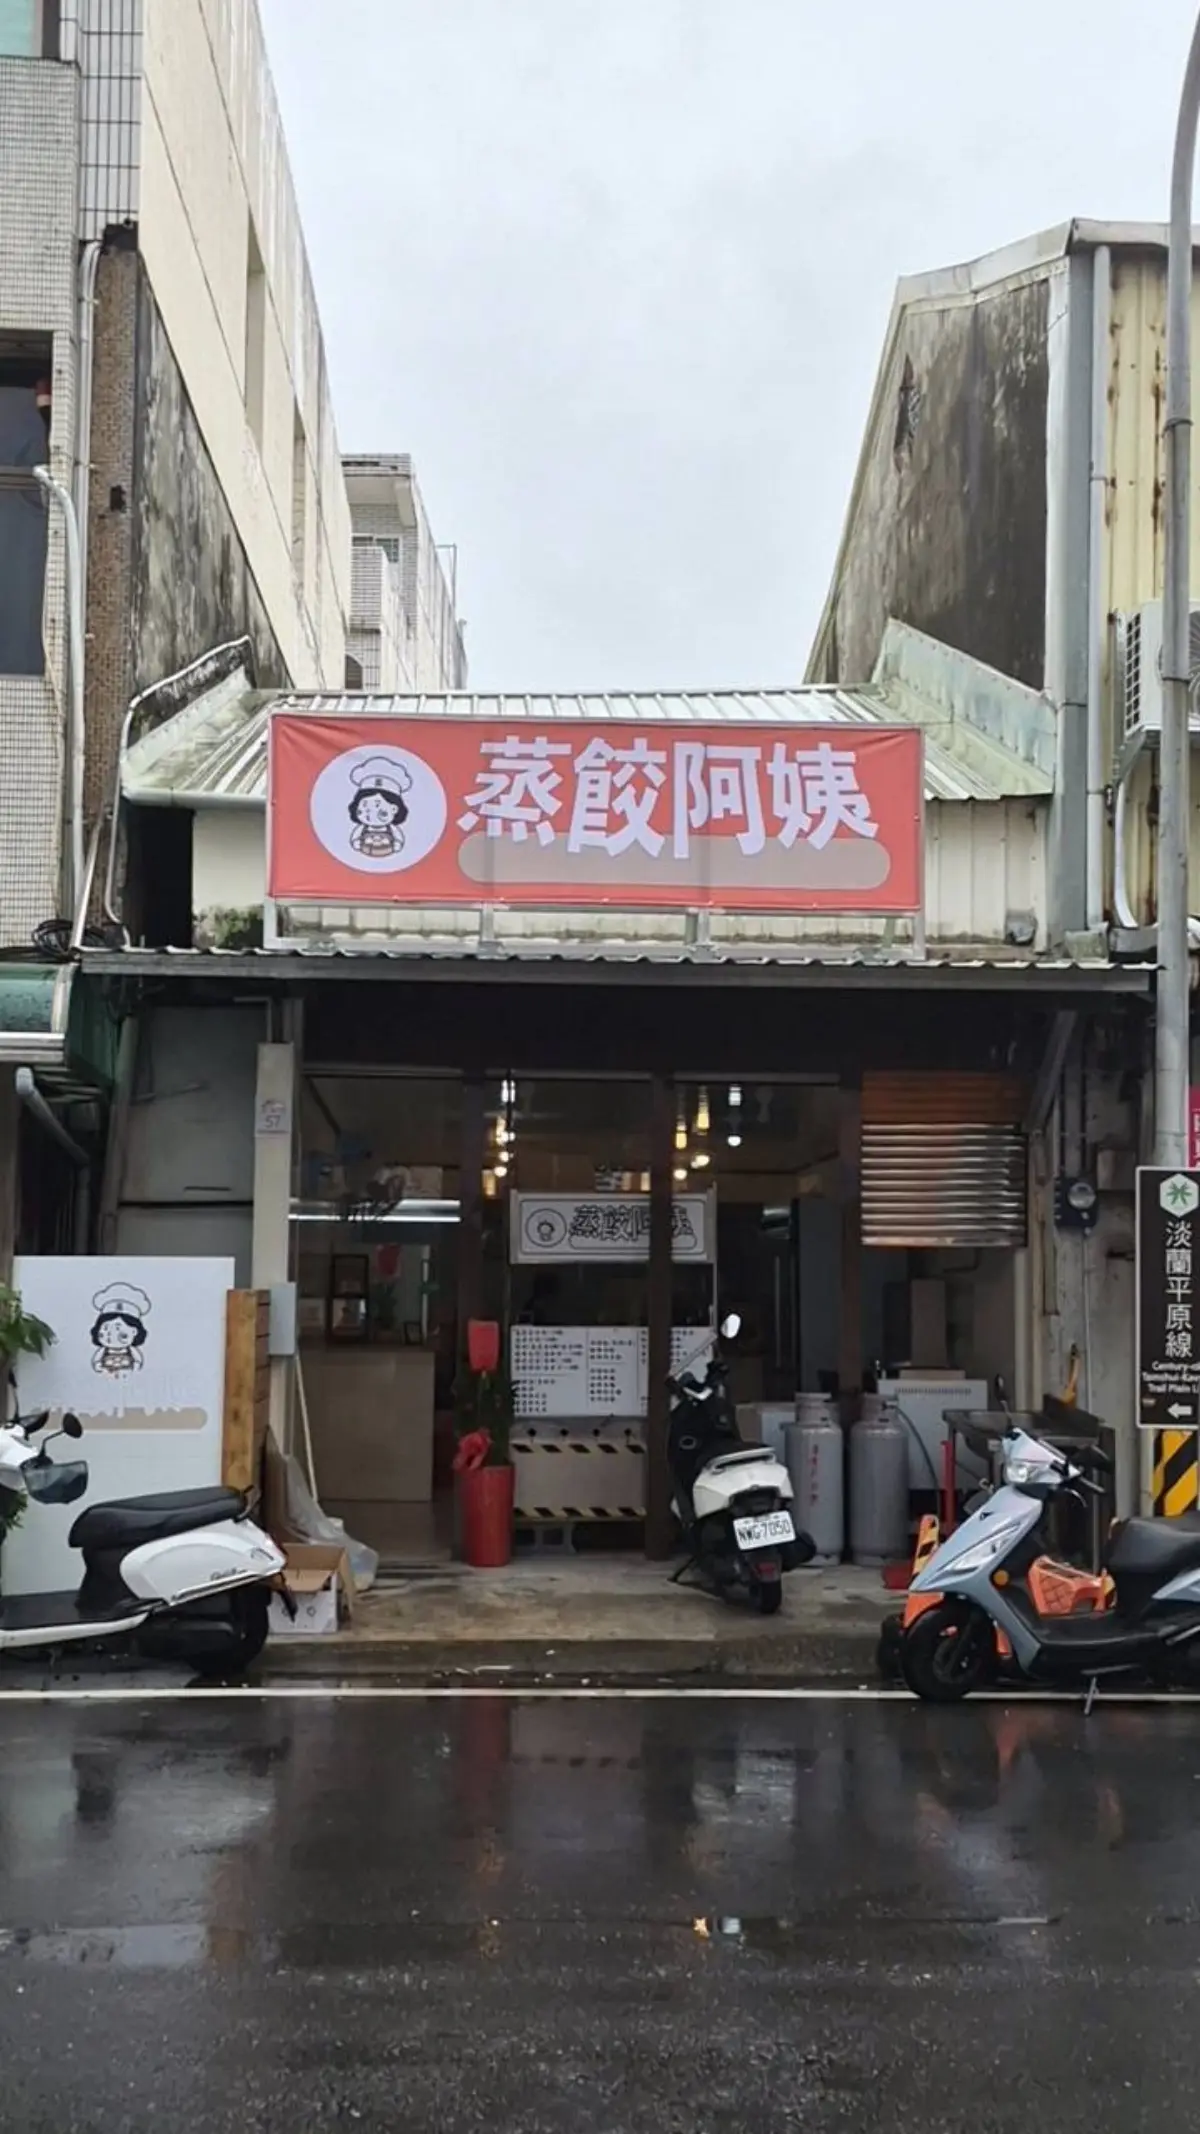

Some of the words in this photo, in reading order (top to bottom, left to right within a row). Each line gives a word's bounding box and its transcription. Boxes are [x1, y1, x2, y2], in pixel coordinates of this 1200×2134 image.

[457, 735, 879, 859] 蒸餃阿姨
[1165, 1220, 1193, 1358] 淡蘭平原線
